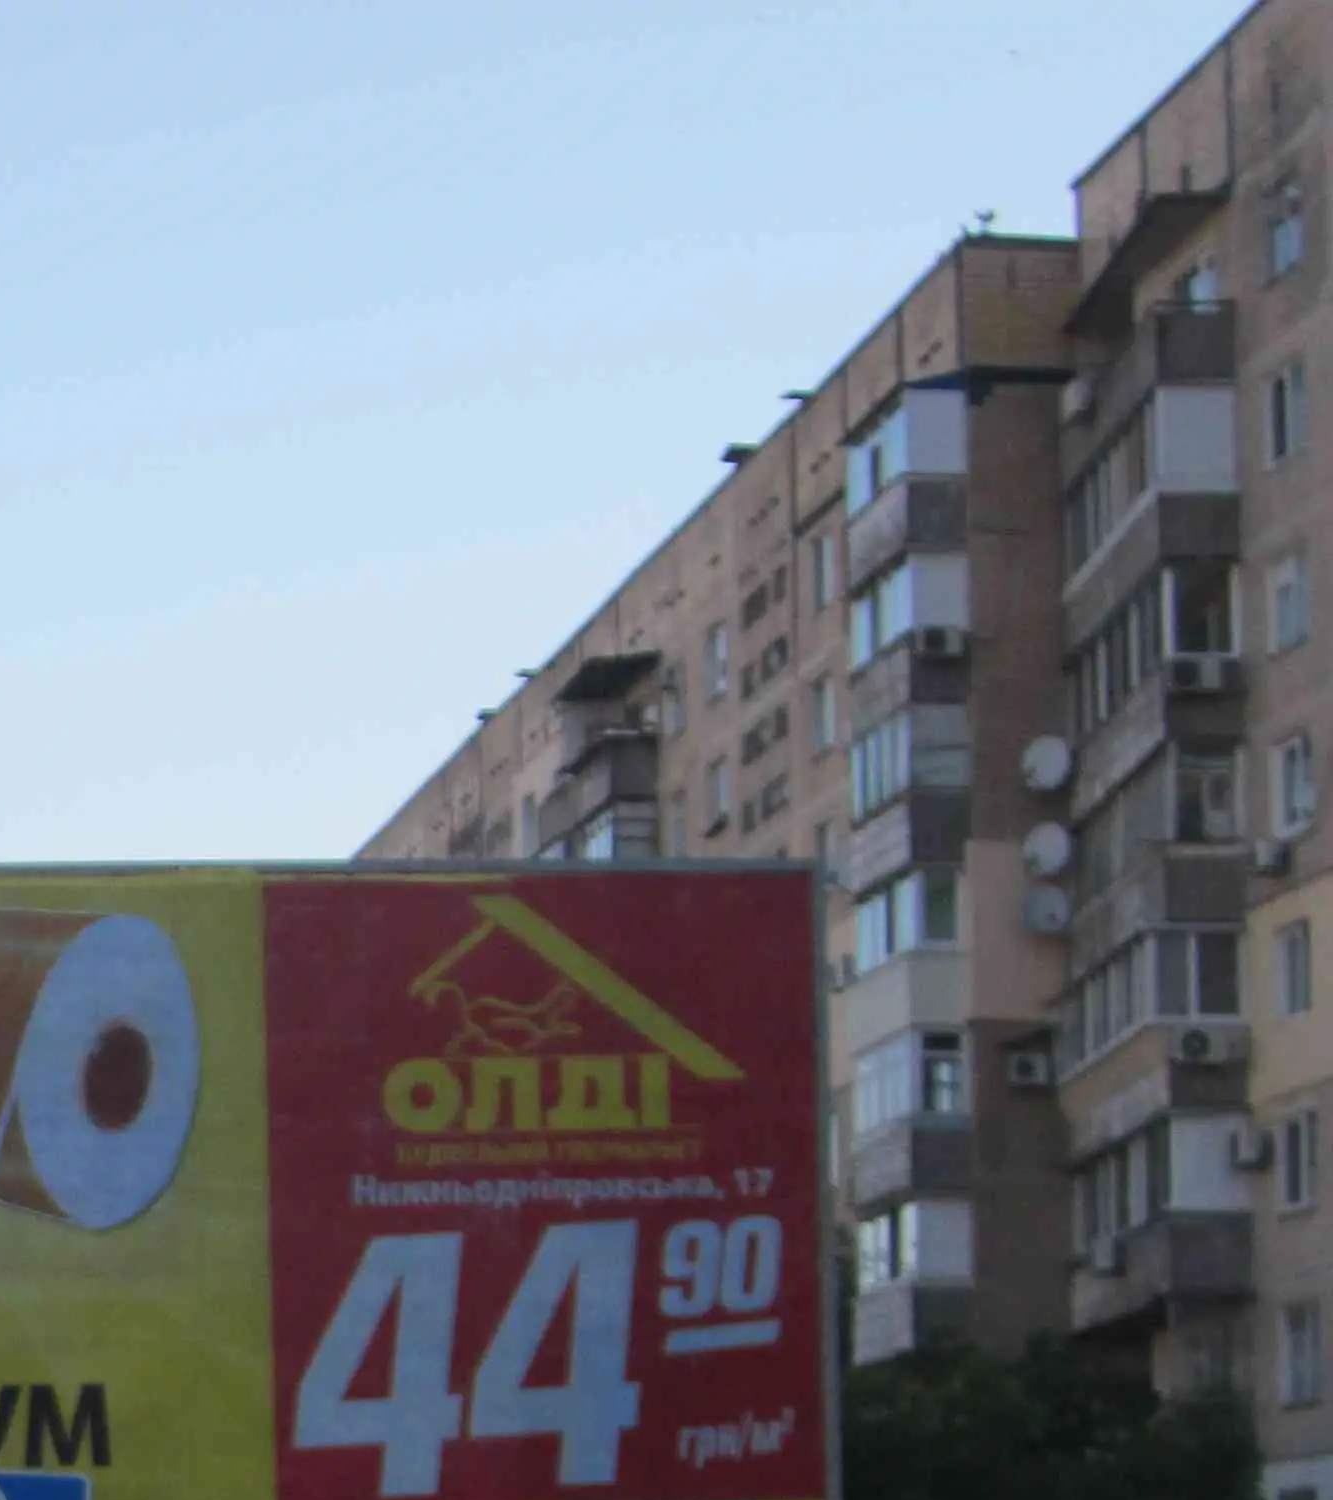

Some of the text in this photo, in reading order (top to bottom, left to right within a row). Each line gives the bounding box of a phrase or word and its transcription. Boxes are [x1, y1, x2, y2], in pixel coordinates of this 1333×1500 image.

[382, 1053, 673, 1133] ОЛДІ
[732, 1167, 776, 1197] 17
[292, 1214, 785, 1497] 44 90
